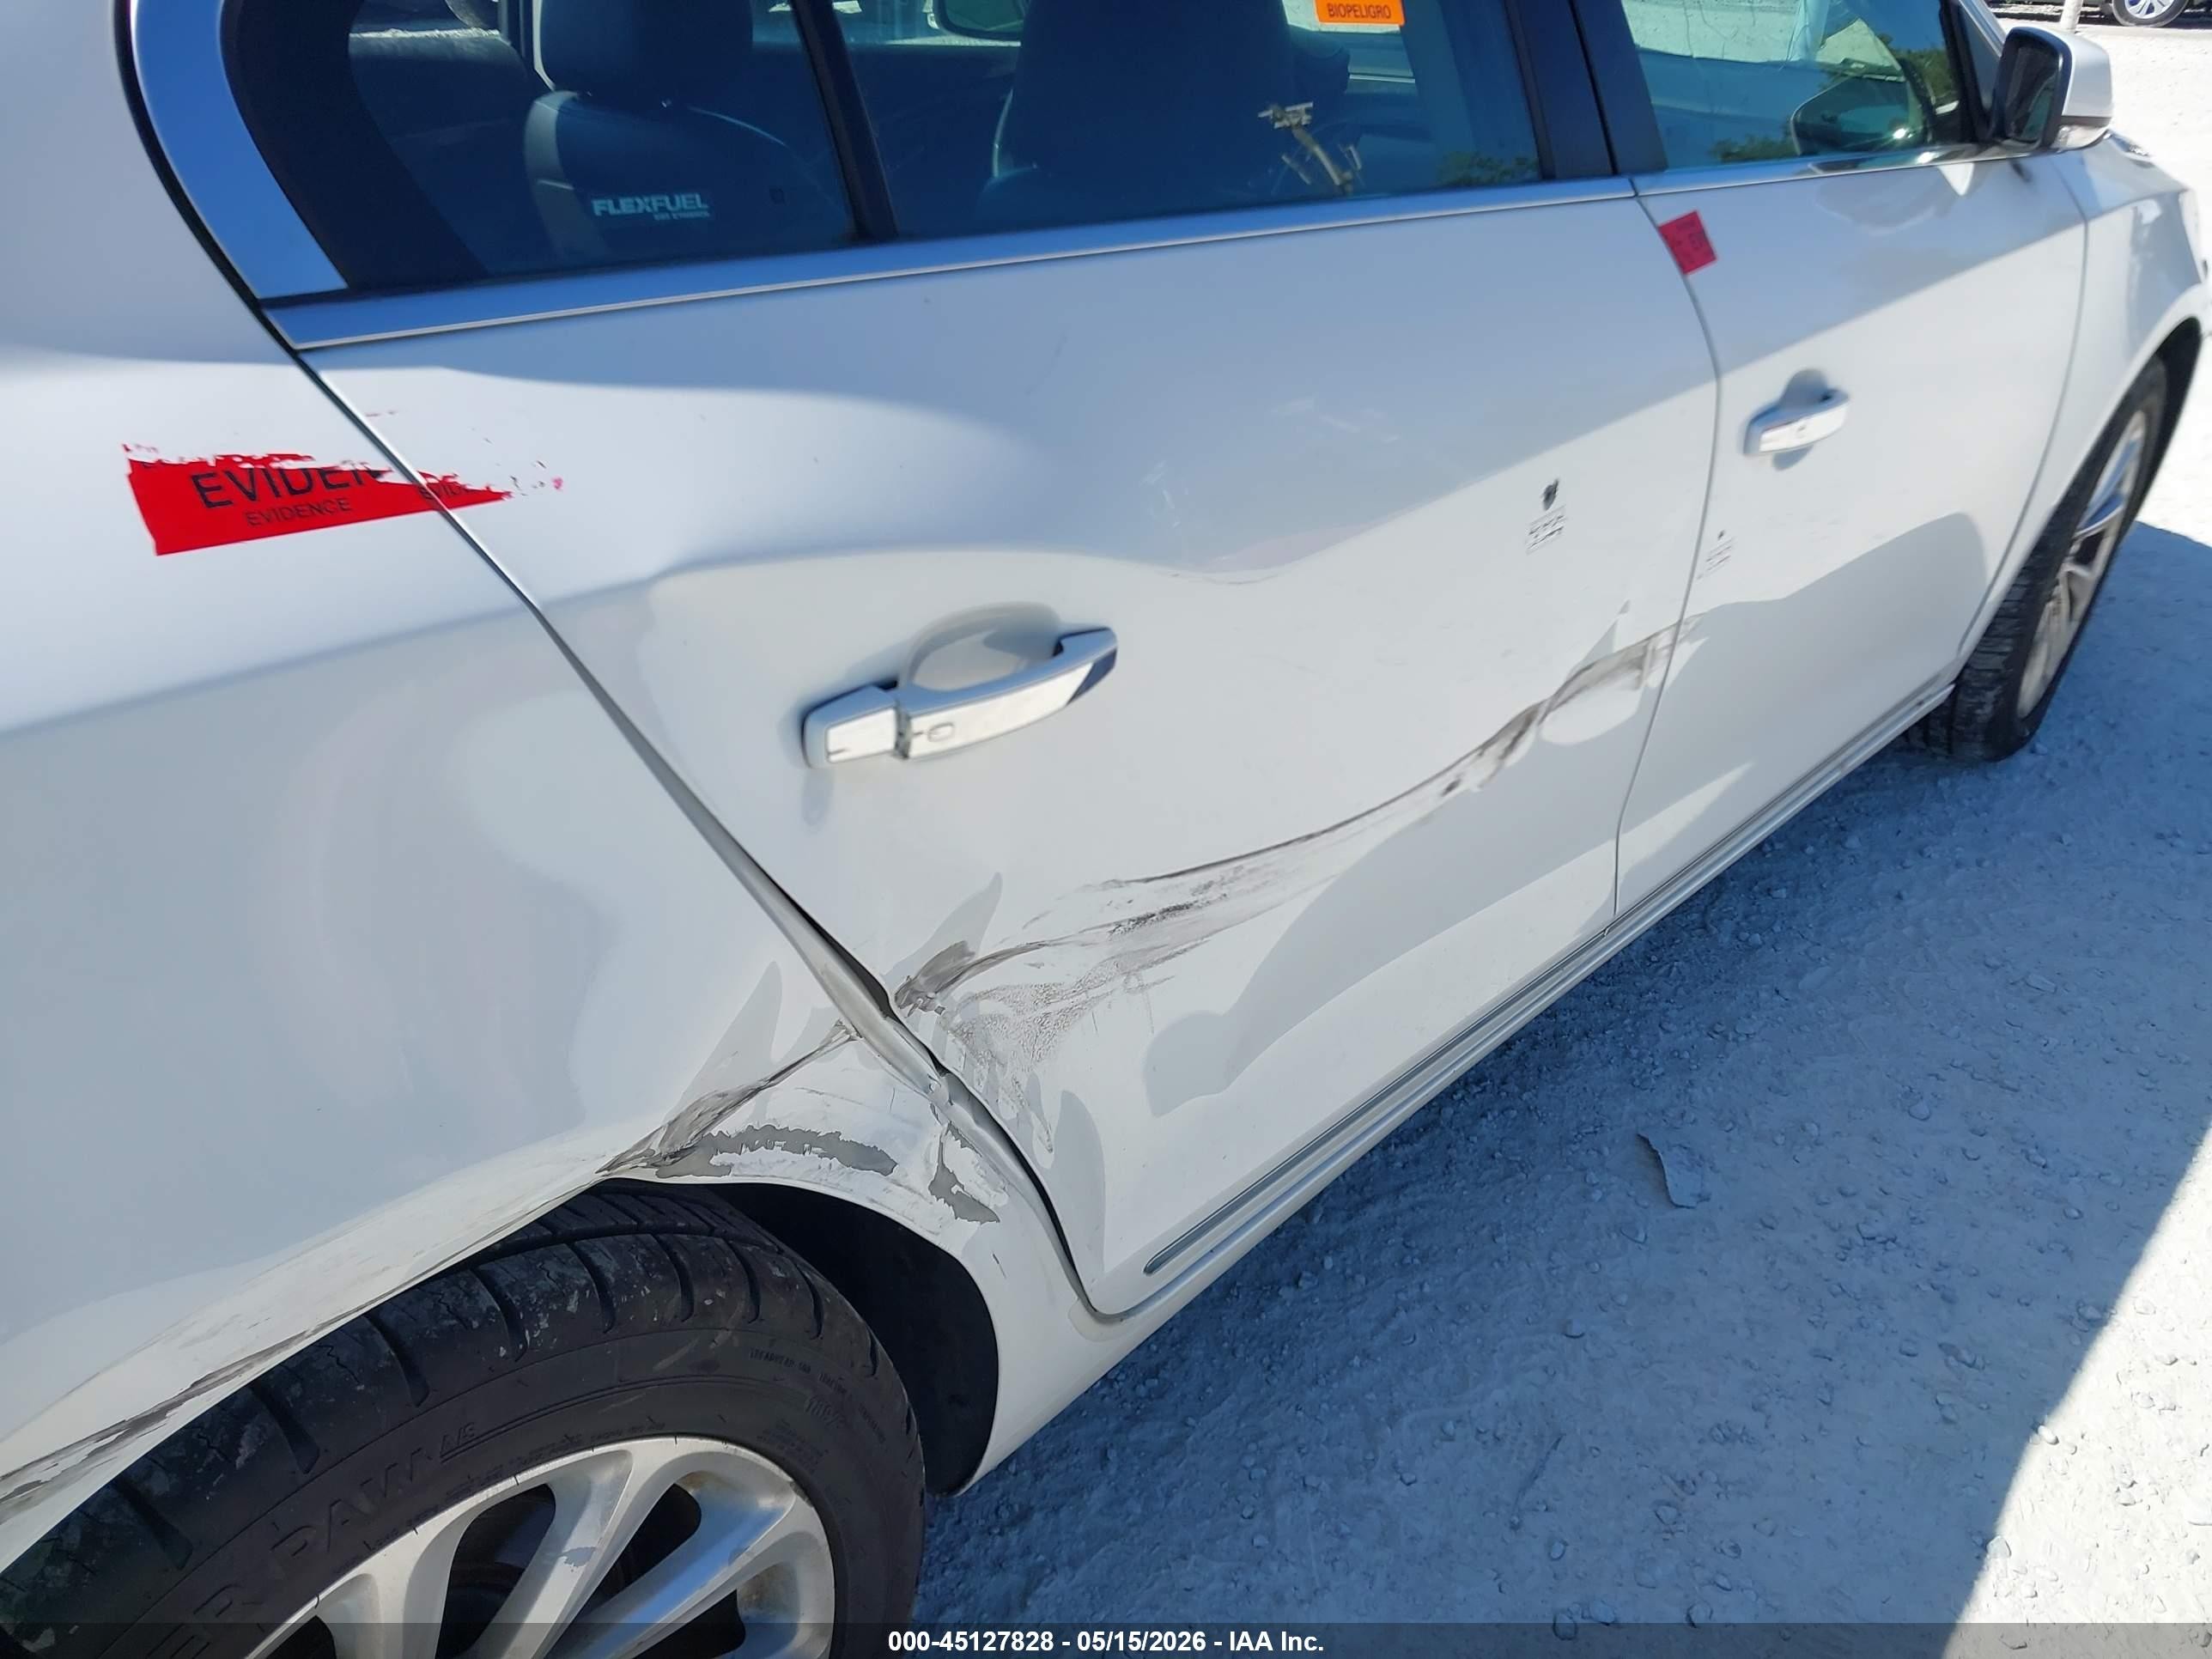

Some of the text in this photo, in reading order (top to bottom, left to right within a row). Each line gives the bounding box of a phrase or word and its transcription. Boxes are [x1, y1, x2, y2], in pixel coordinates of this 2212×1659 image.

[1328, 3, 1391, 19] BIOPELIGRO
[592, 192, 709, 216] FLEXFUEL
[245, 497, 352, 526] EVIDENCE
